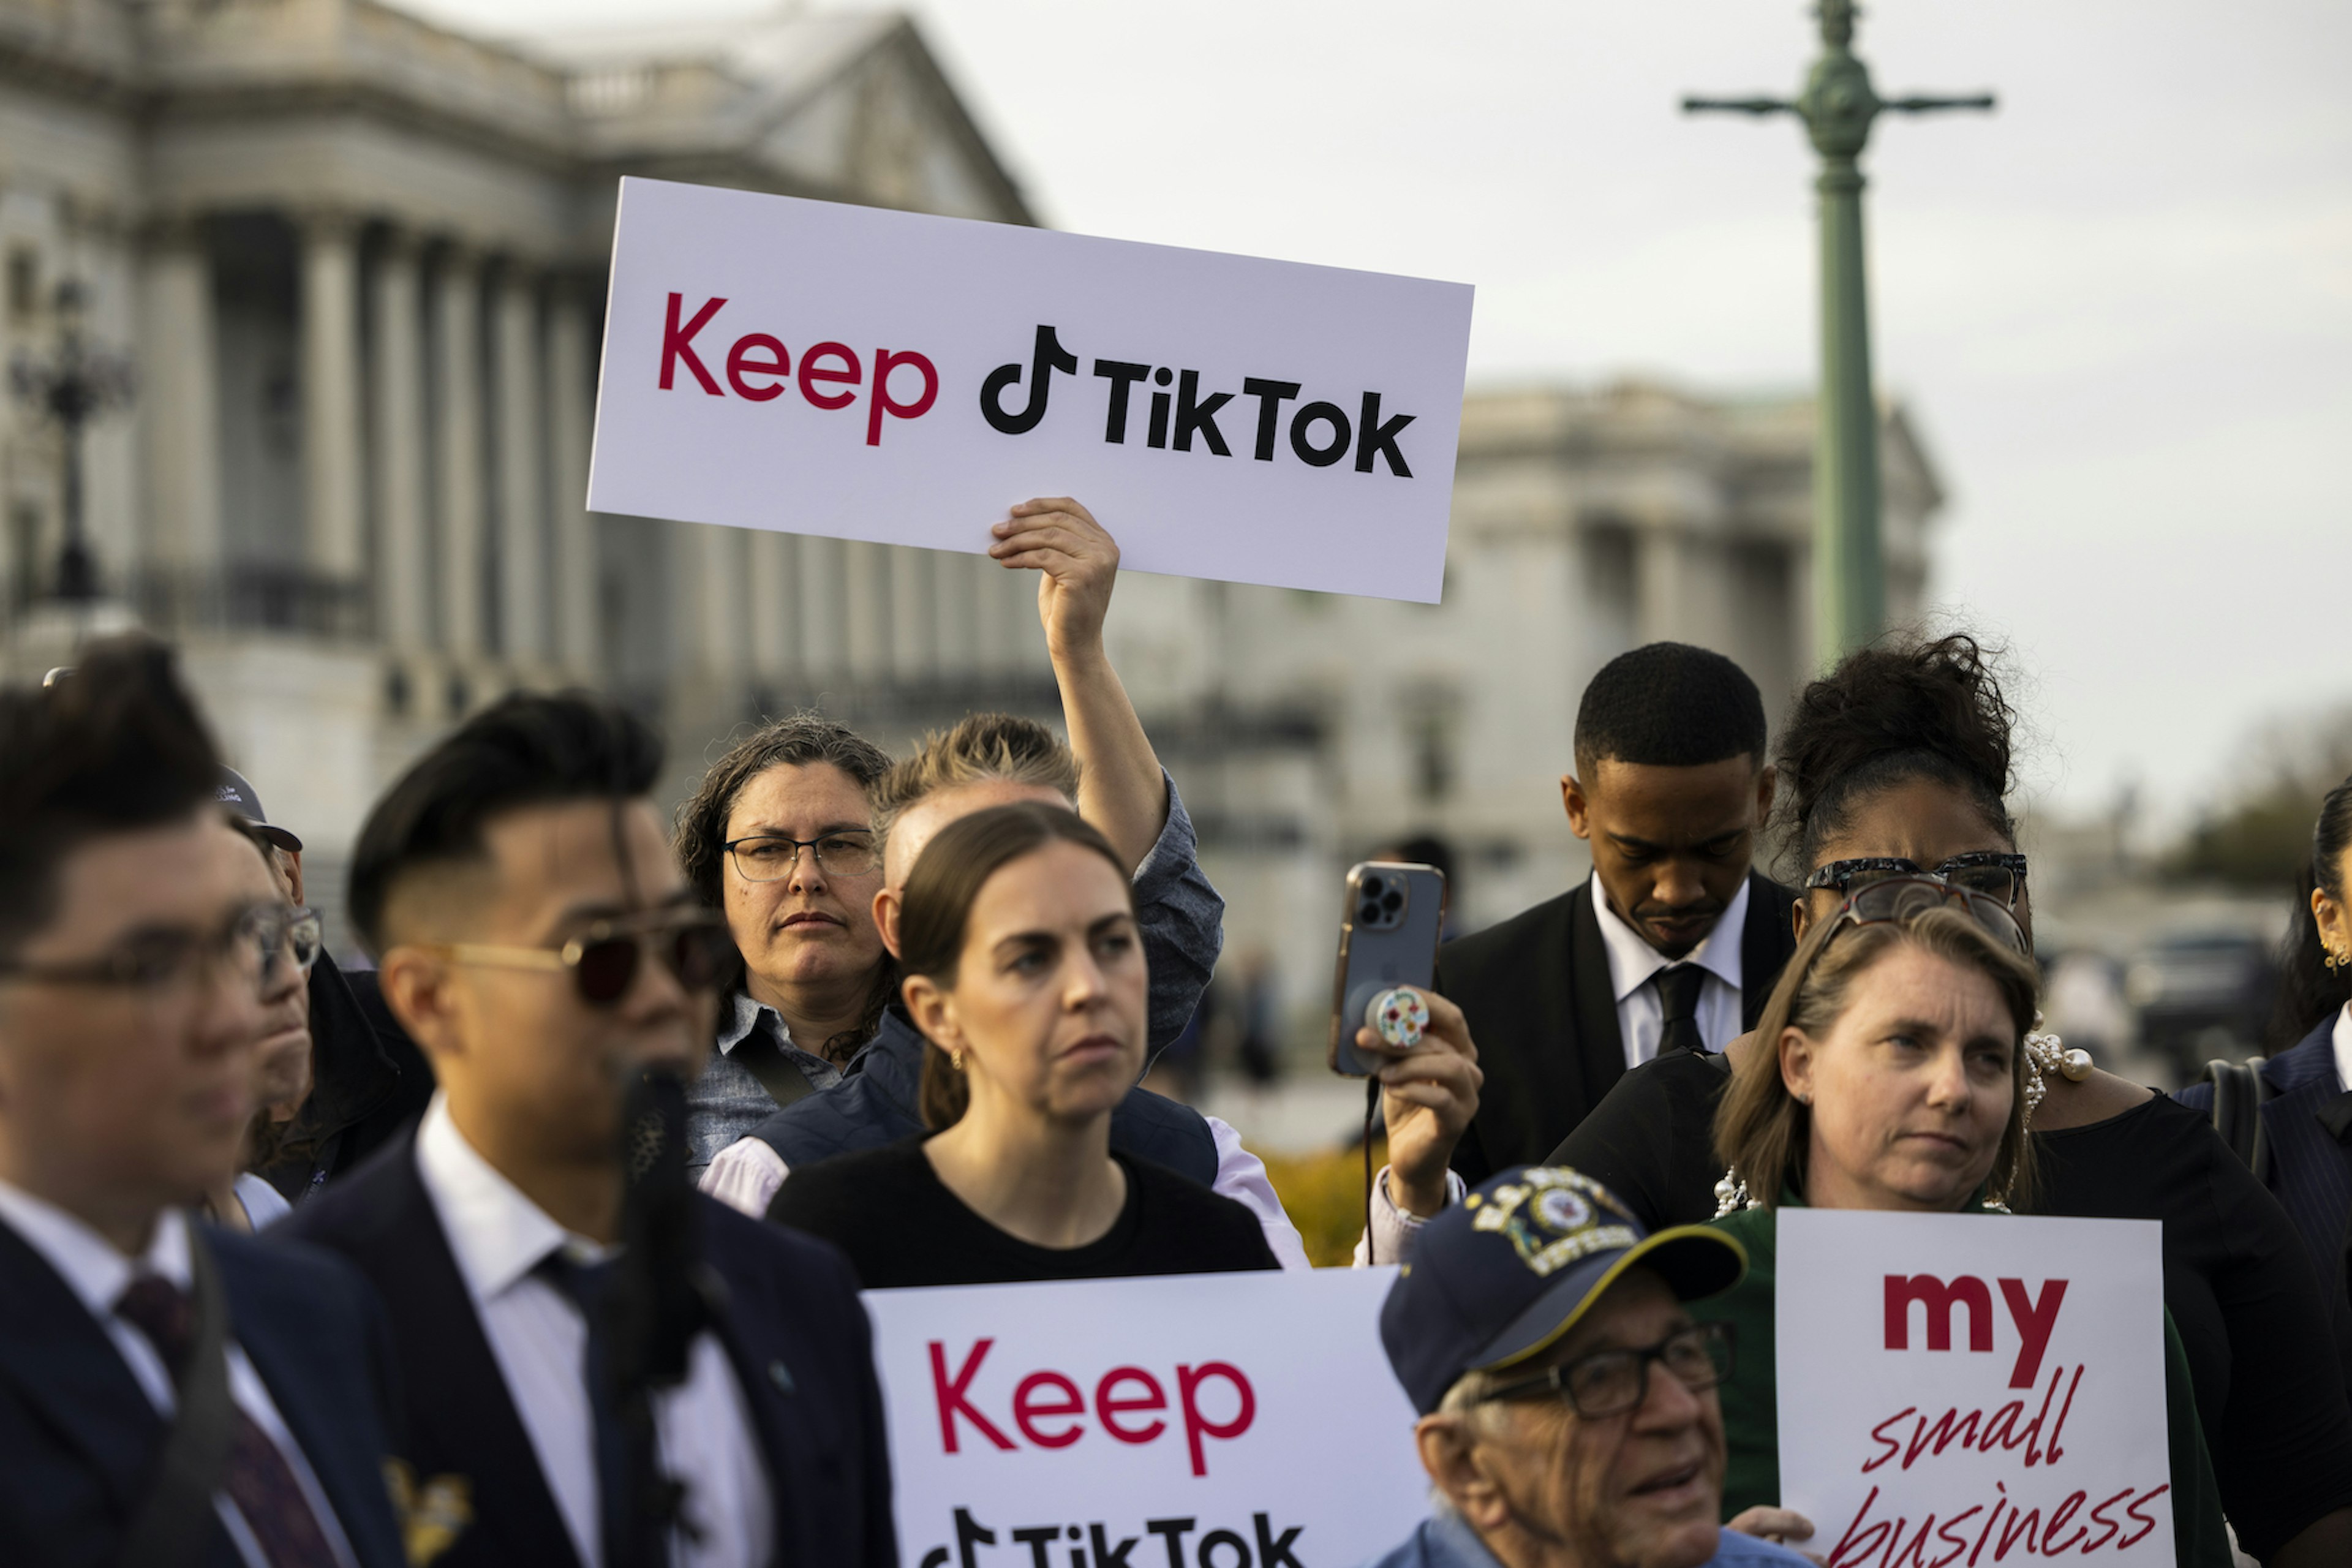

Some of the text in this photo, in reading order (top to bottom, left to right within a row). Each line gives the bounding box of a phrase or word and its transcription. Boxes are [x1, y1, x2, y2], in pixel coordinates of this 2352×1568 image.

[658, 291, 1417, 479] Keep TikTok
[1883, 1274, 2069, 1389] my
[927, 1338, 1257, 1478] Keep
[1861, 1363, 2085, 1474] small
[1828, 1480, 2170, 1568] business
